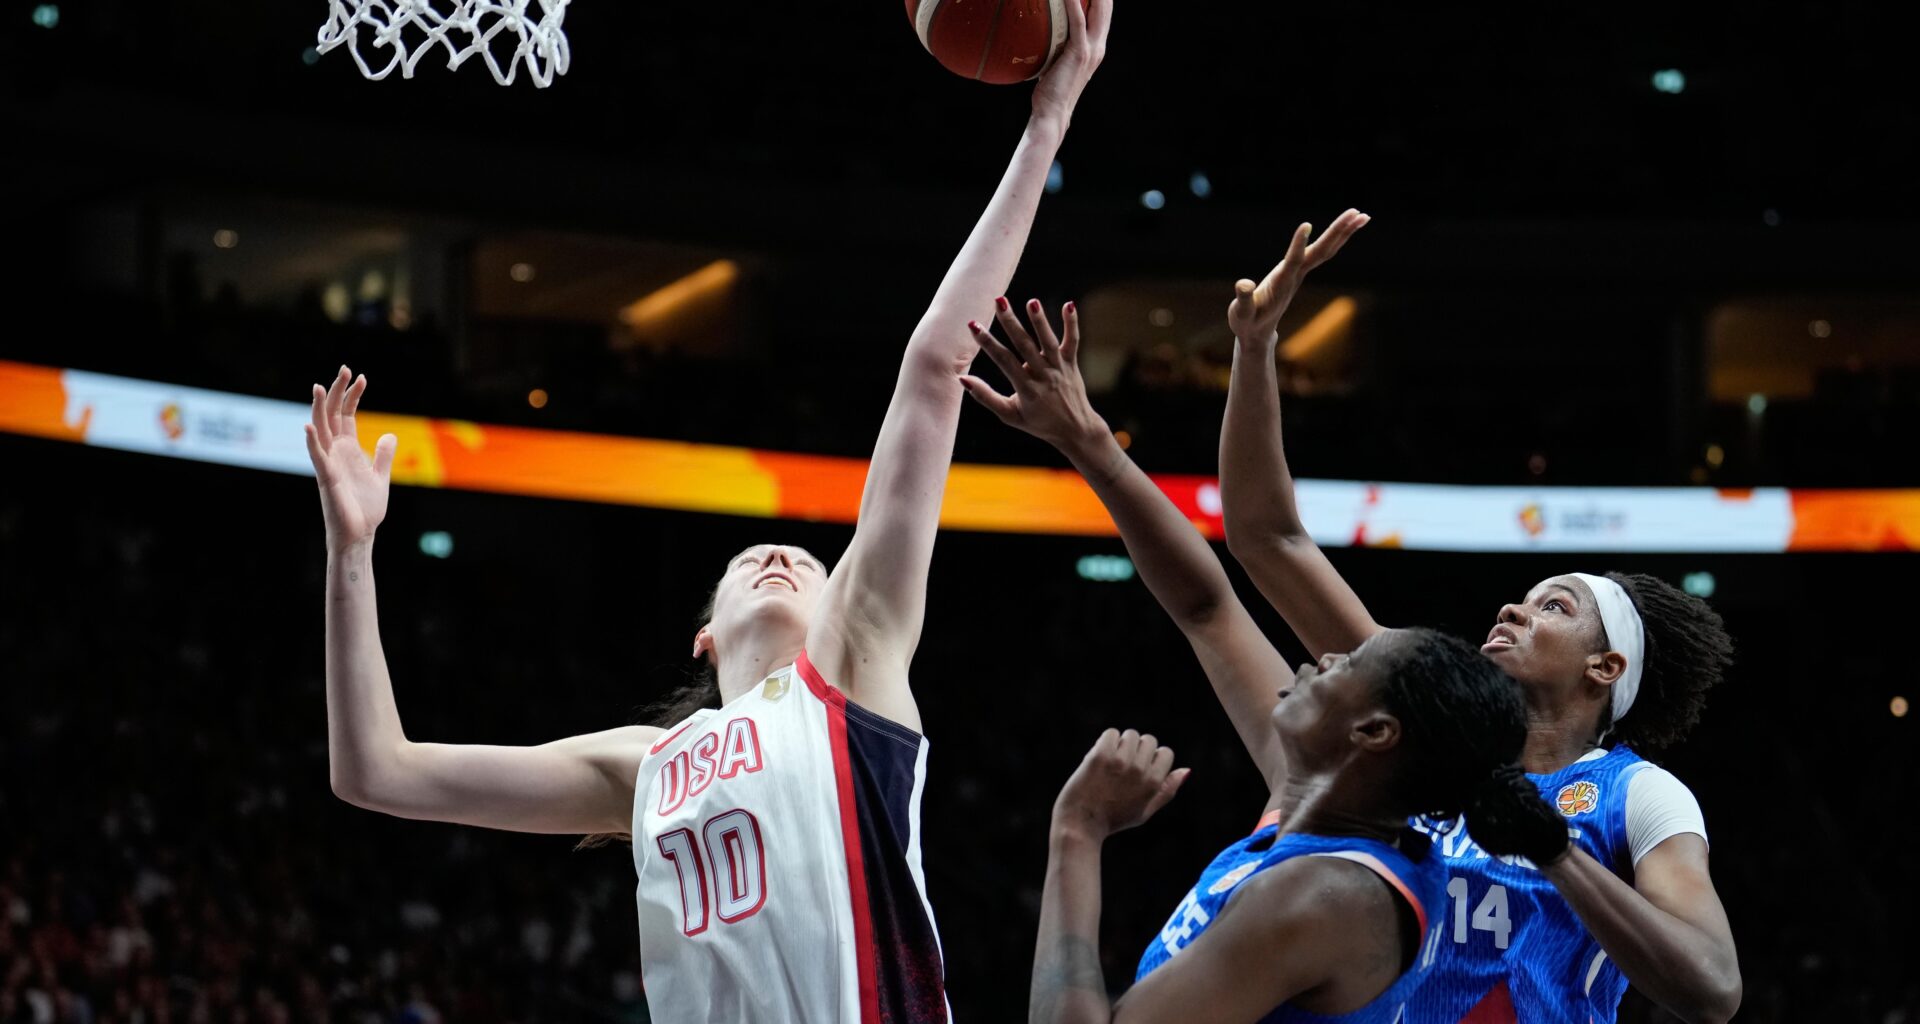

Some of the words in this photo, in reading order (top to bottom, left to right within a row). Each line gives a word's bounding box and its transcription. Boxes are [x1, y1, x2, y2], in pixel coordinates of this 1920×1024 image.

[659, 718, 763, 816] USA
[657, 809, 767, 937] 10
[1447, 878, 1511, 949] 14
